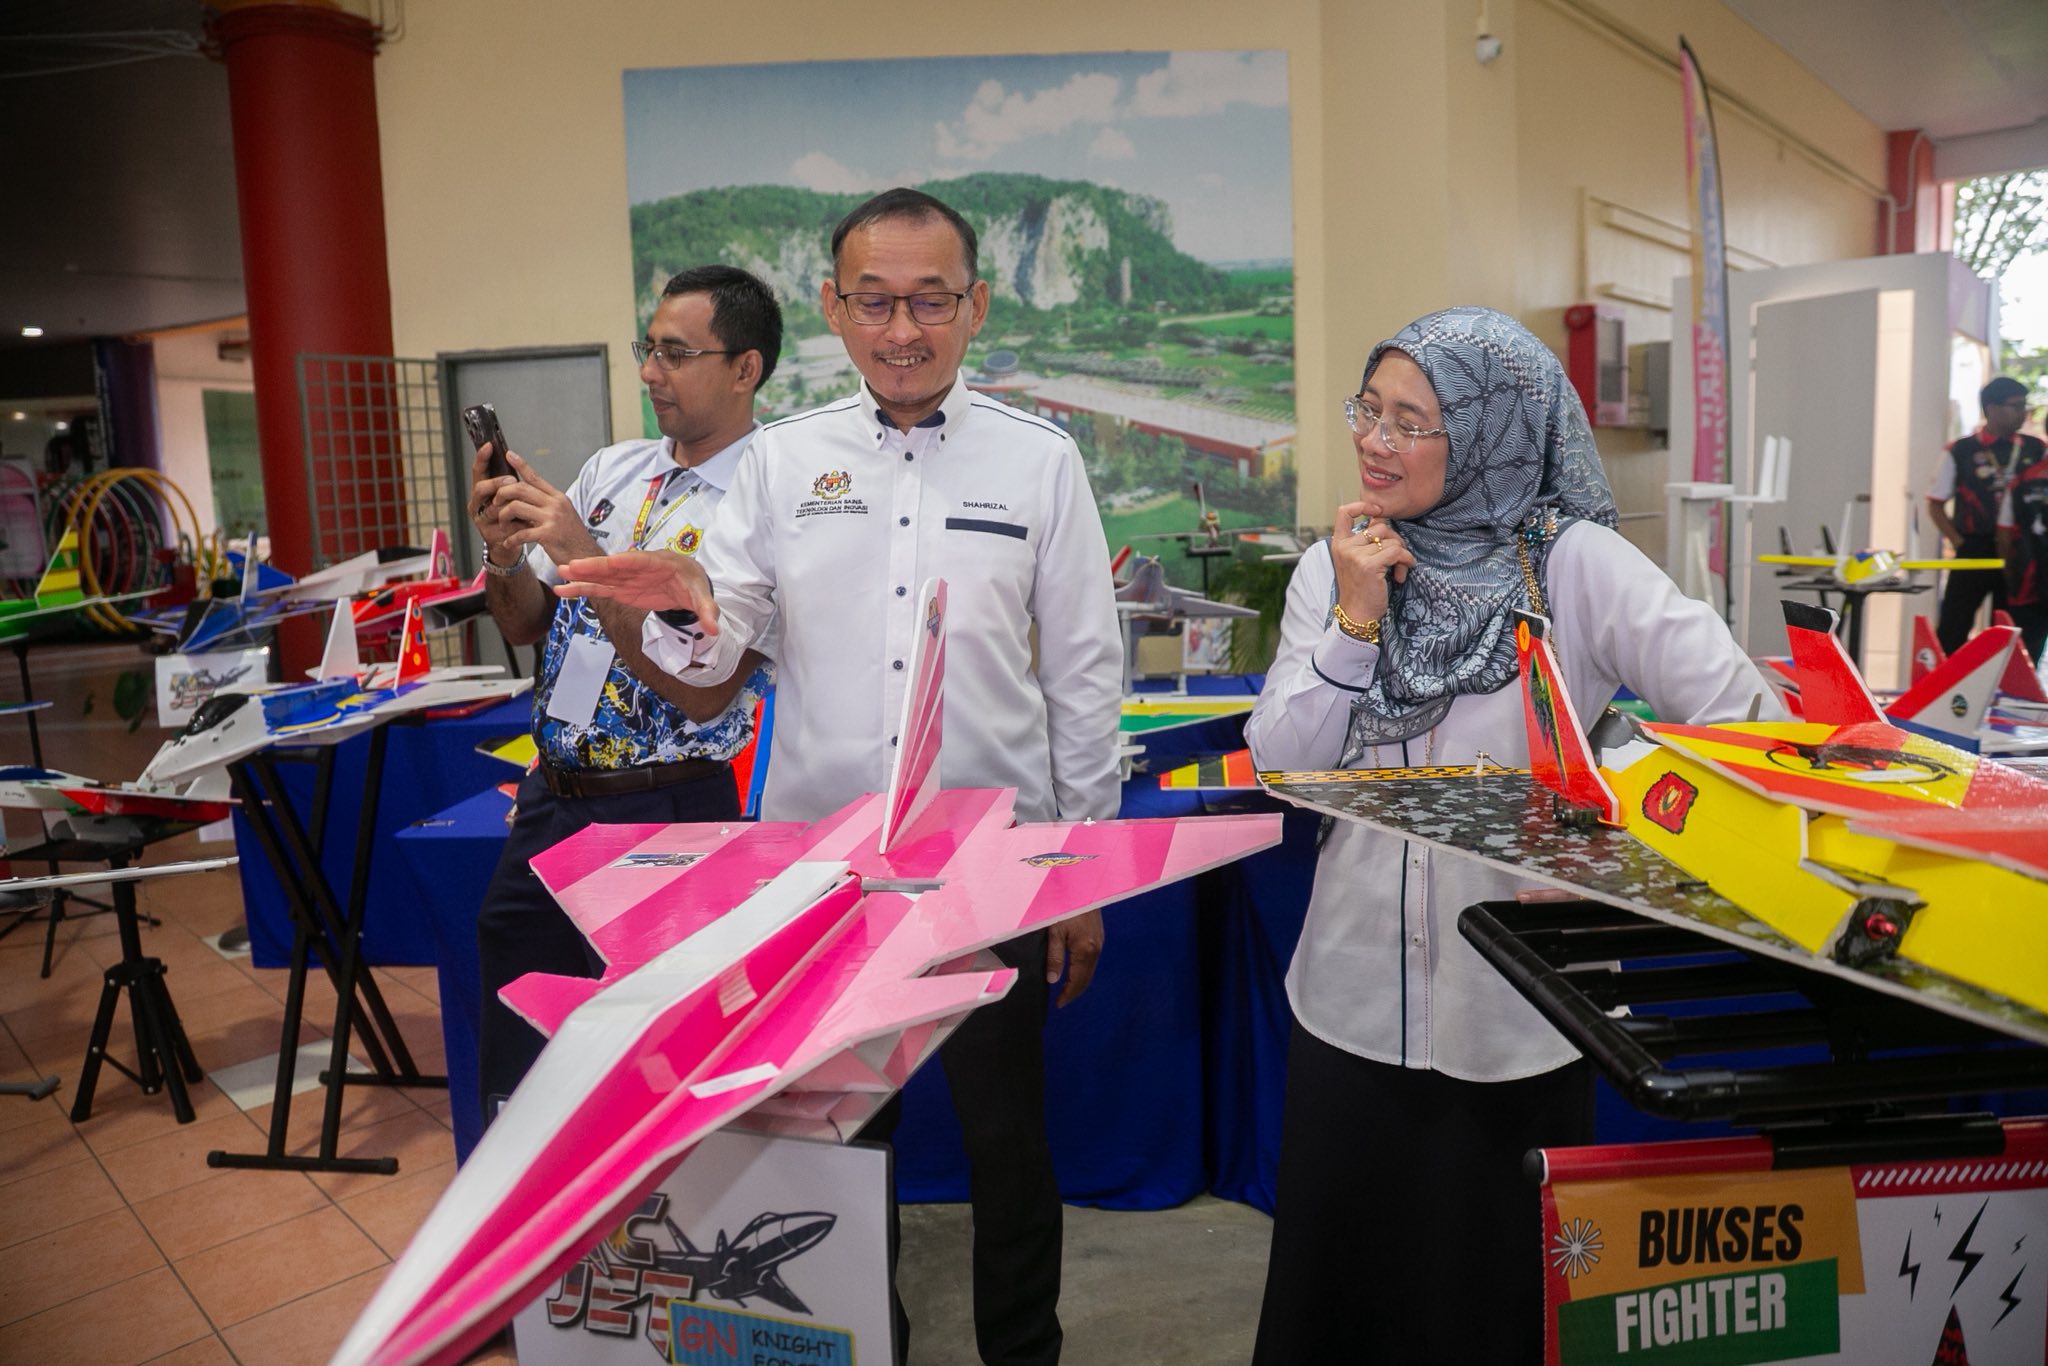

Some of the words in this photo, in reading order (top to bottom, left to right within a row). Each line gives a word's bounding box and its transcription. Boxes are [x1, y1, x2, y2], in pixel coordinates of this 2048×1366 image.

[796, 506, 828, 515] TEKNOLOGI
[800, 500, 842, 508] KEMENTERIAN
[963, 501, 1009, 511] SHAHRIZAL
[1638, 1204, 1804, 1268] BUKSES
[546, 1261, 694, 1363] JET
[1615, 1273, 1787, 1353] FIGHTER
[679, 1316, 738, 1358] GN
[752, 1328, 836, 1358] KNIGHT
